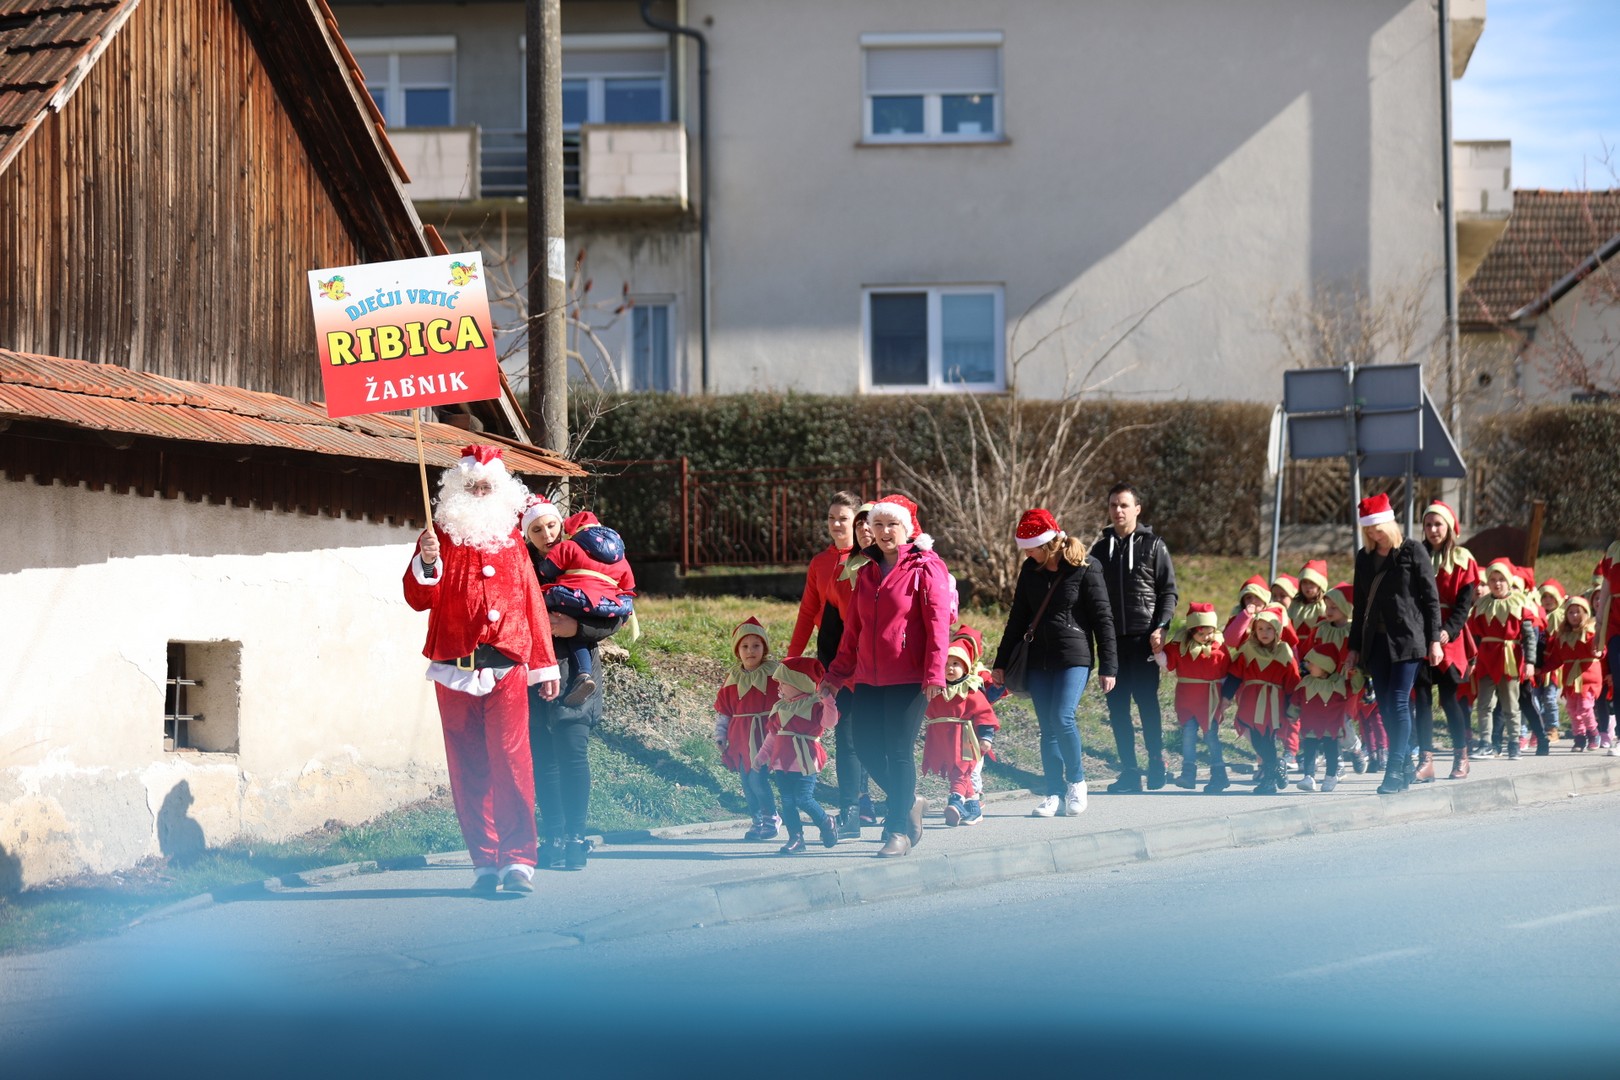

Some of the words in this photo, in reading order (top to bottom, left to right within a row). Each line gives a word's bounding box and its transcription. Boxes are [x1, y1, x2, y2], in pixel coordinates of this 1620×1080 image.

[345, 288, 402, 321] DJEČJI
[406, 289, 461, 309] VRTIĆ
[327, 315, 488, 366] RIBICA
[365, 371, 468, 402] ŽABNIK
